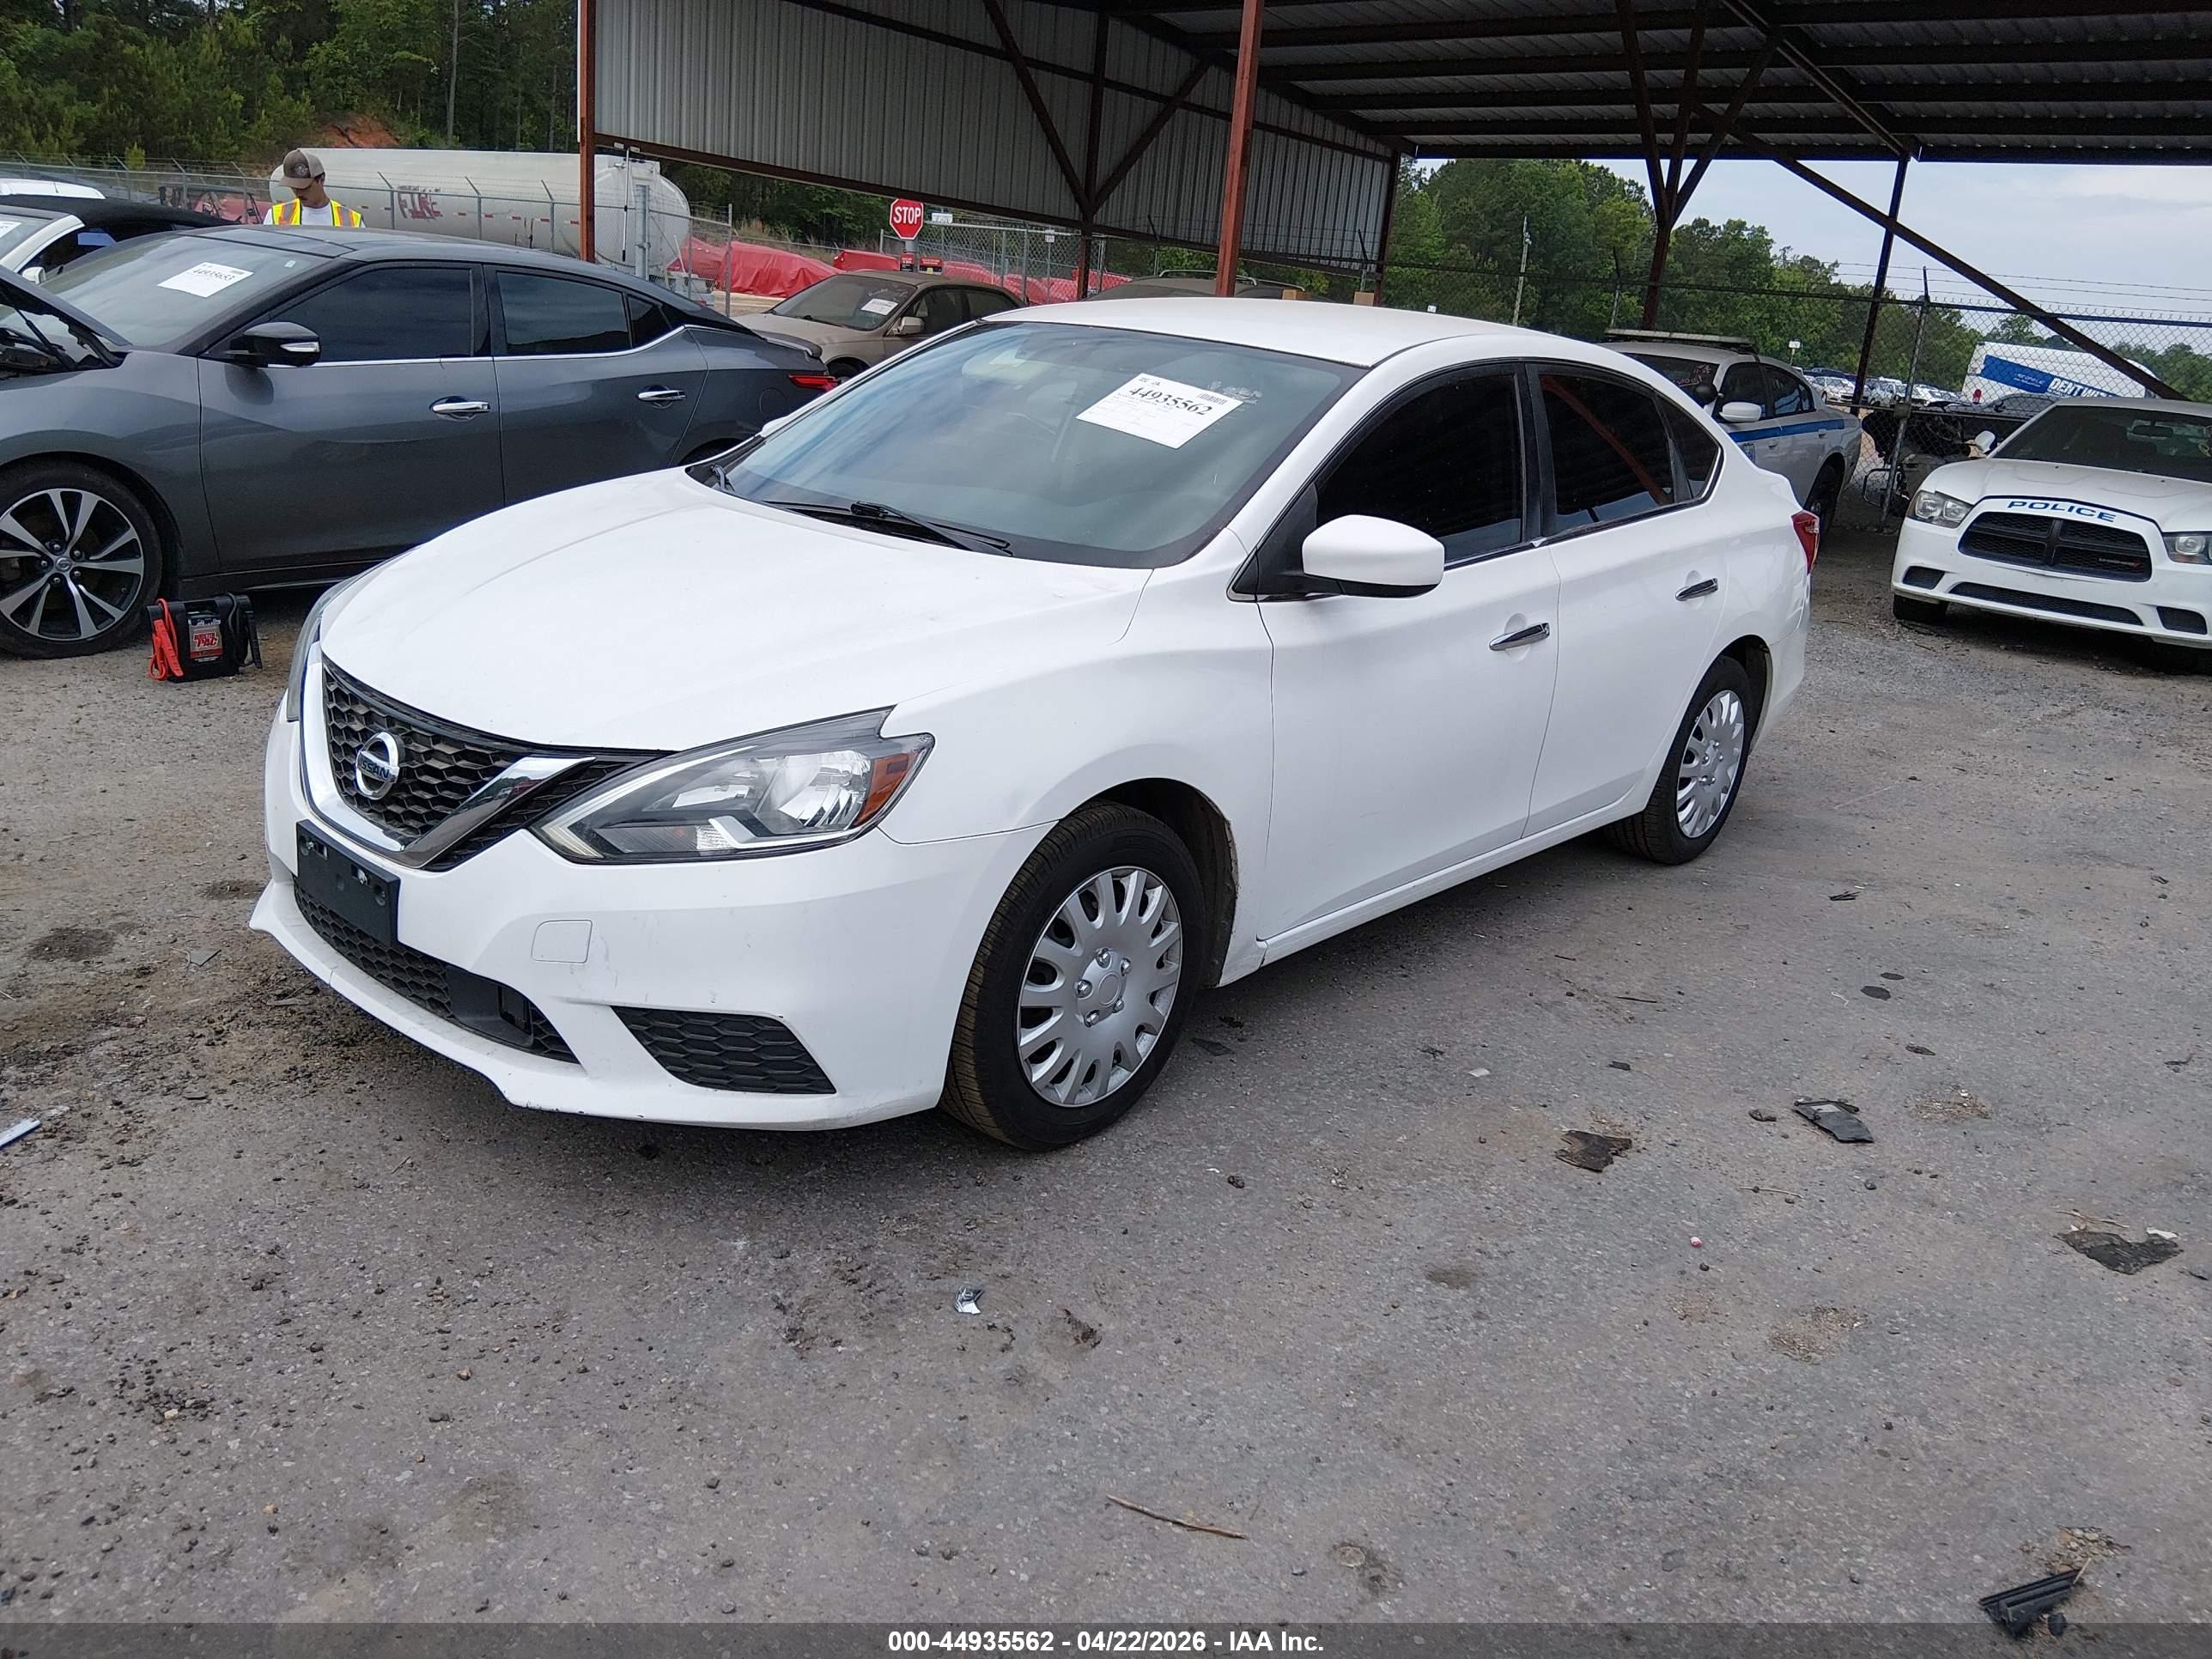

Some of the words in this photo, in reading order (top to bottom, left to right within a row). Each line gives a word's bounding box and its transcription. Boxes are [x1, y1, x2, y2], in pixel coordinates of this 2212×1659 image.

[893, 206, 921, 225] STOP
[2049, 378, 2082, 398] DENT
[1128, 386, 1213, 416] 44935562
[2007, 501, 2117, 523] POLICE
[196, 638, 218, 648] PAC
